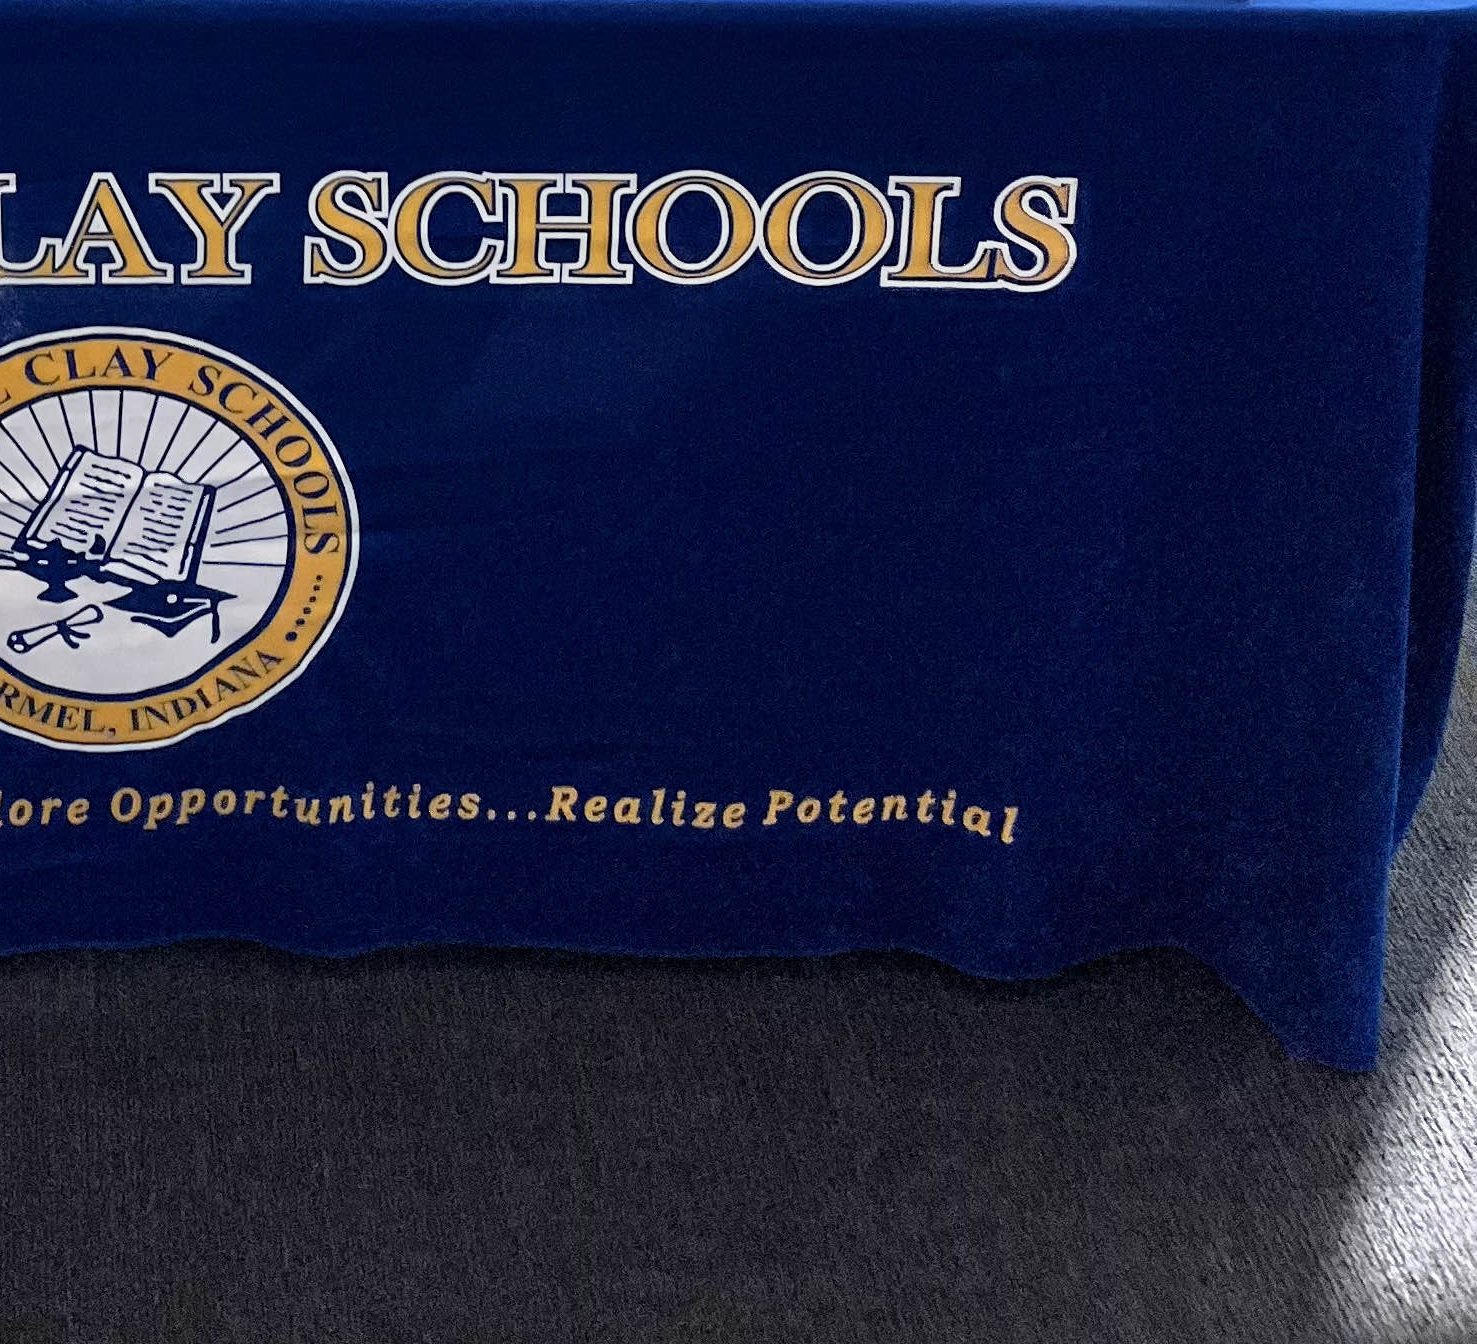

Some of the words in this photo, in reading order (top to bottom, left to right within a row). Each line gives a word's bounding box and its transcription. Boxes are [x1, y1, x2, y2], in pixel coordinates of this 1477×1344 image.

[303, 169, 1079, 293] SCHOOLS
[23, 346, 175, 387] CLAY
[188, 364, 340, 557] SCHOOLS
[130, 649, 284, 733] INDIANA
[762, 789, 1020, 845] Potential
